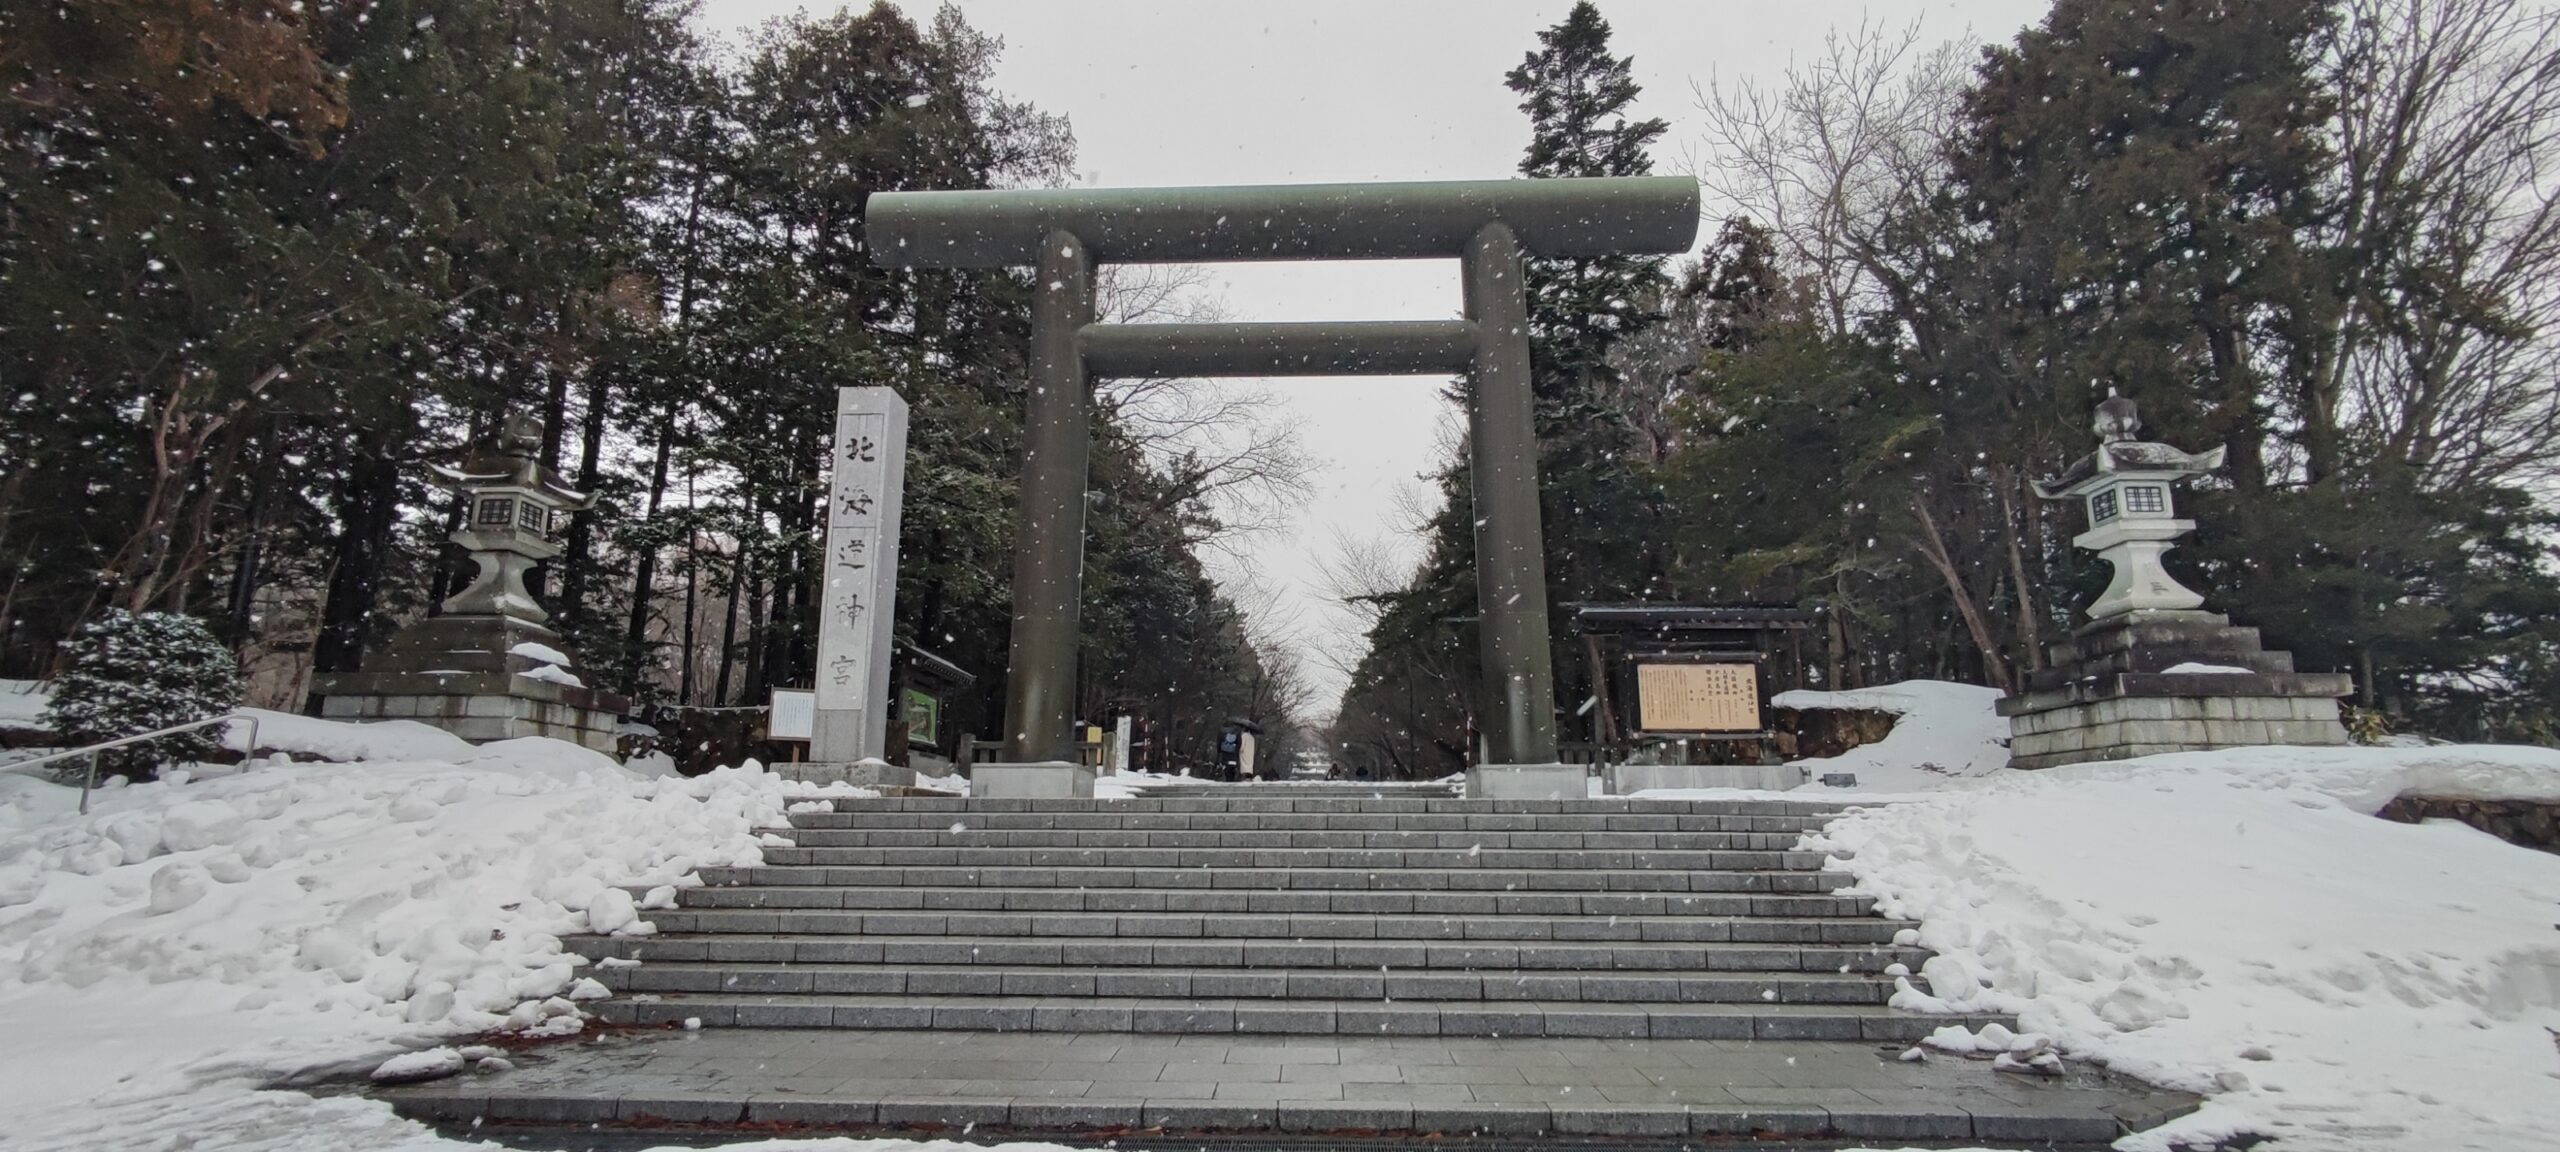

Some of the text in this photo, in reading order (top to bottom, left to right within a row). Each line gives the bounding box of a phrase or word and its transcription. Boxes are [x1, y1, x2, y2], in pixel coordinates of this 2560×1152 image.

[831, 436, 875, 685] 北海道神宮
